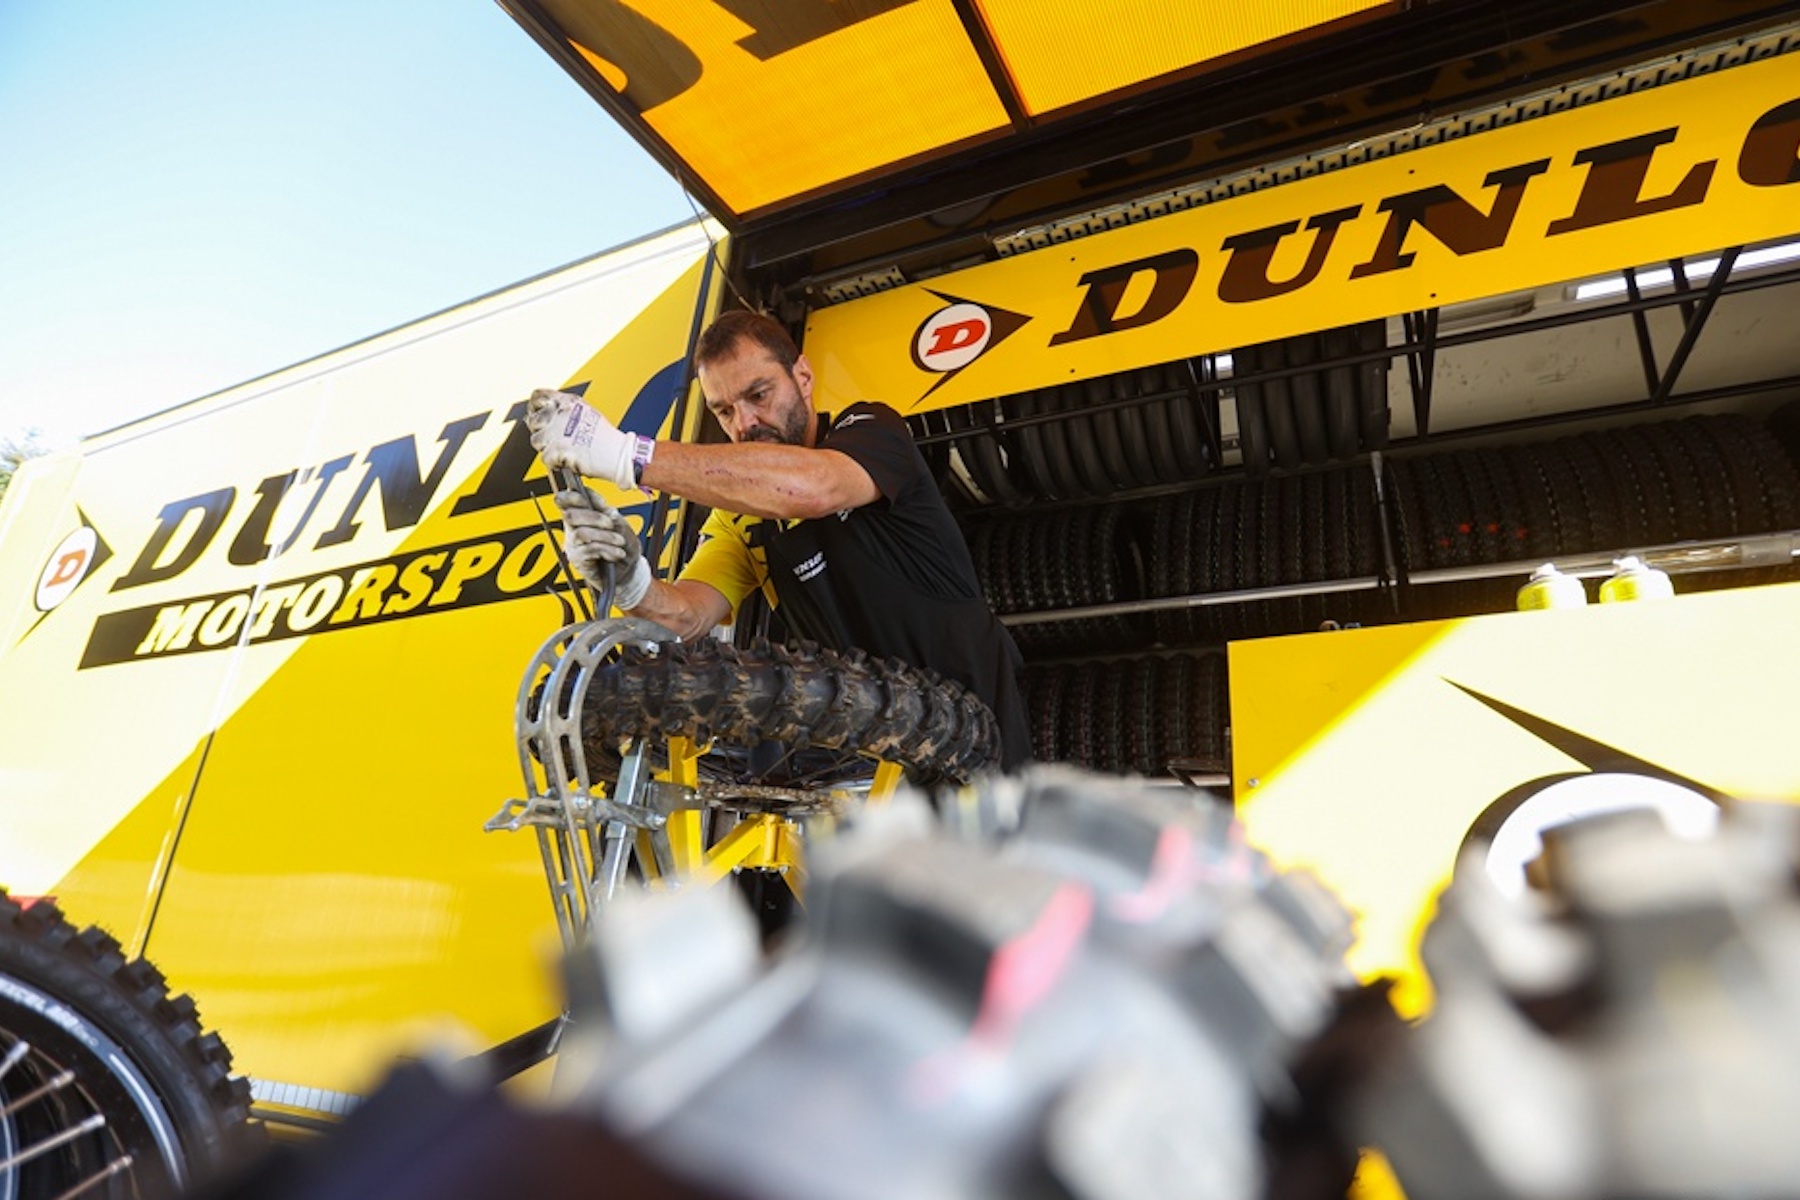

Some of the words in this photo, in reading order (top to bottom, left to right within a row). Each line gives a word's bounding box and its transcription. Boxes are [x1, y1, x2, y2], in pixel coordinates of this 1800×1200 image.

[925, 318, 987, 357] D
[44, 549, 87, 588] D
[134, 505, 680, 656] MOTORSPO
